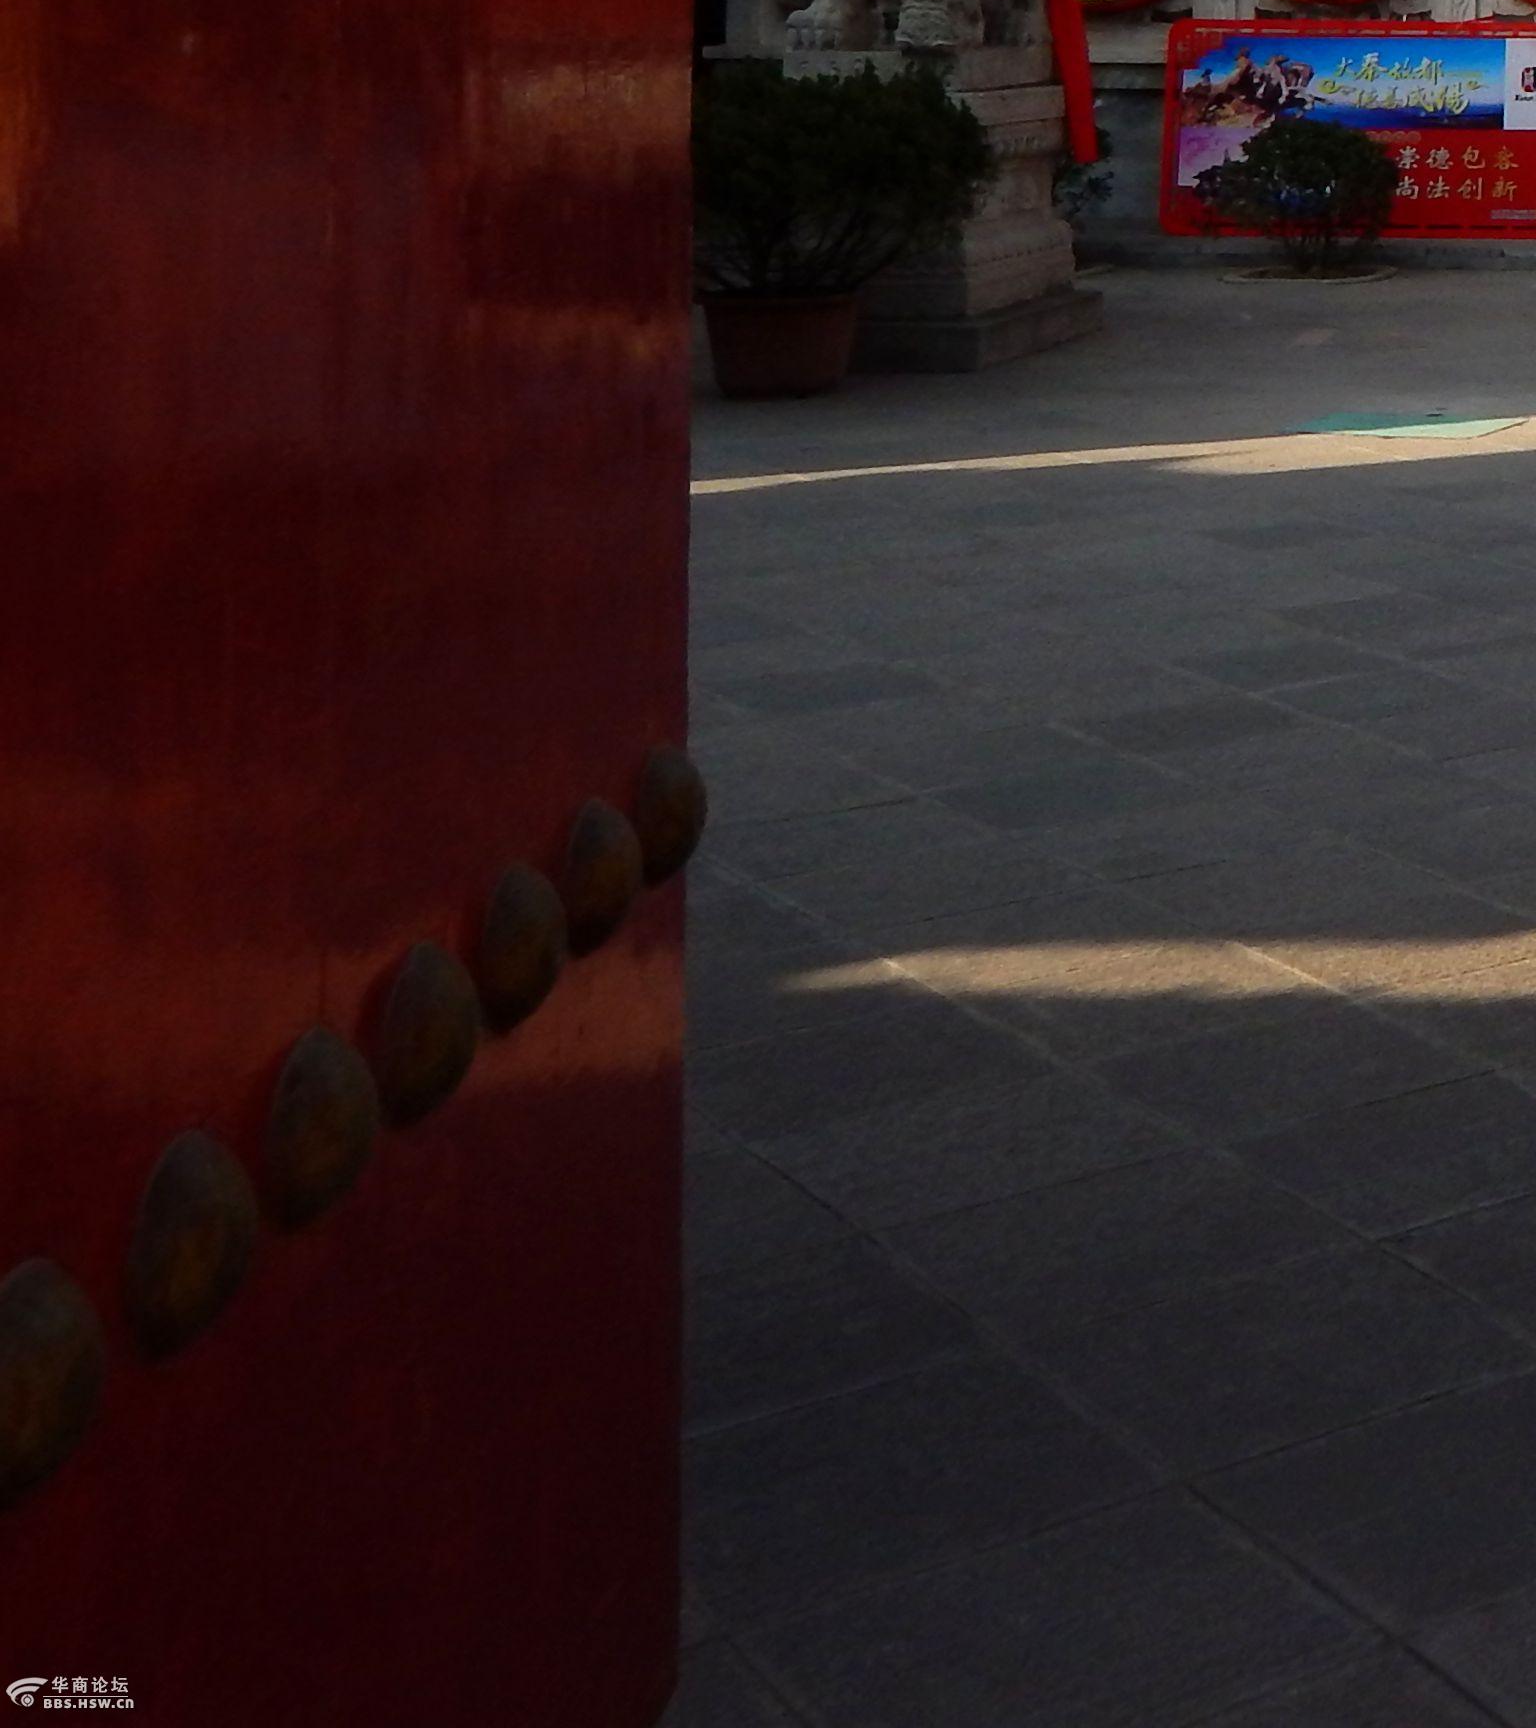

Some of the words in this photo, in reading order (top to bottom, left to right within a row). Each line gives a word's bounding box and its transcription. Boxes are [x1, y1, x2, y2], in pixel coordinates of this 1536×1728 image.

[1396, 145, 1520, 171] 崇德包容
[1396, 175, 1518, 203] 尚法创新
